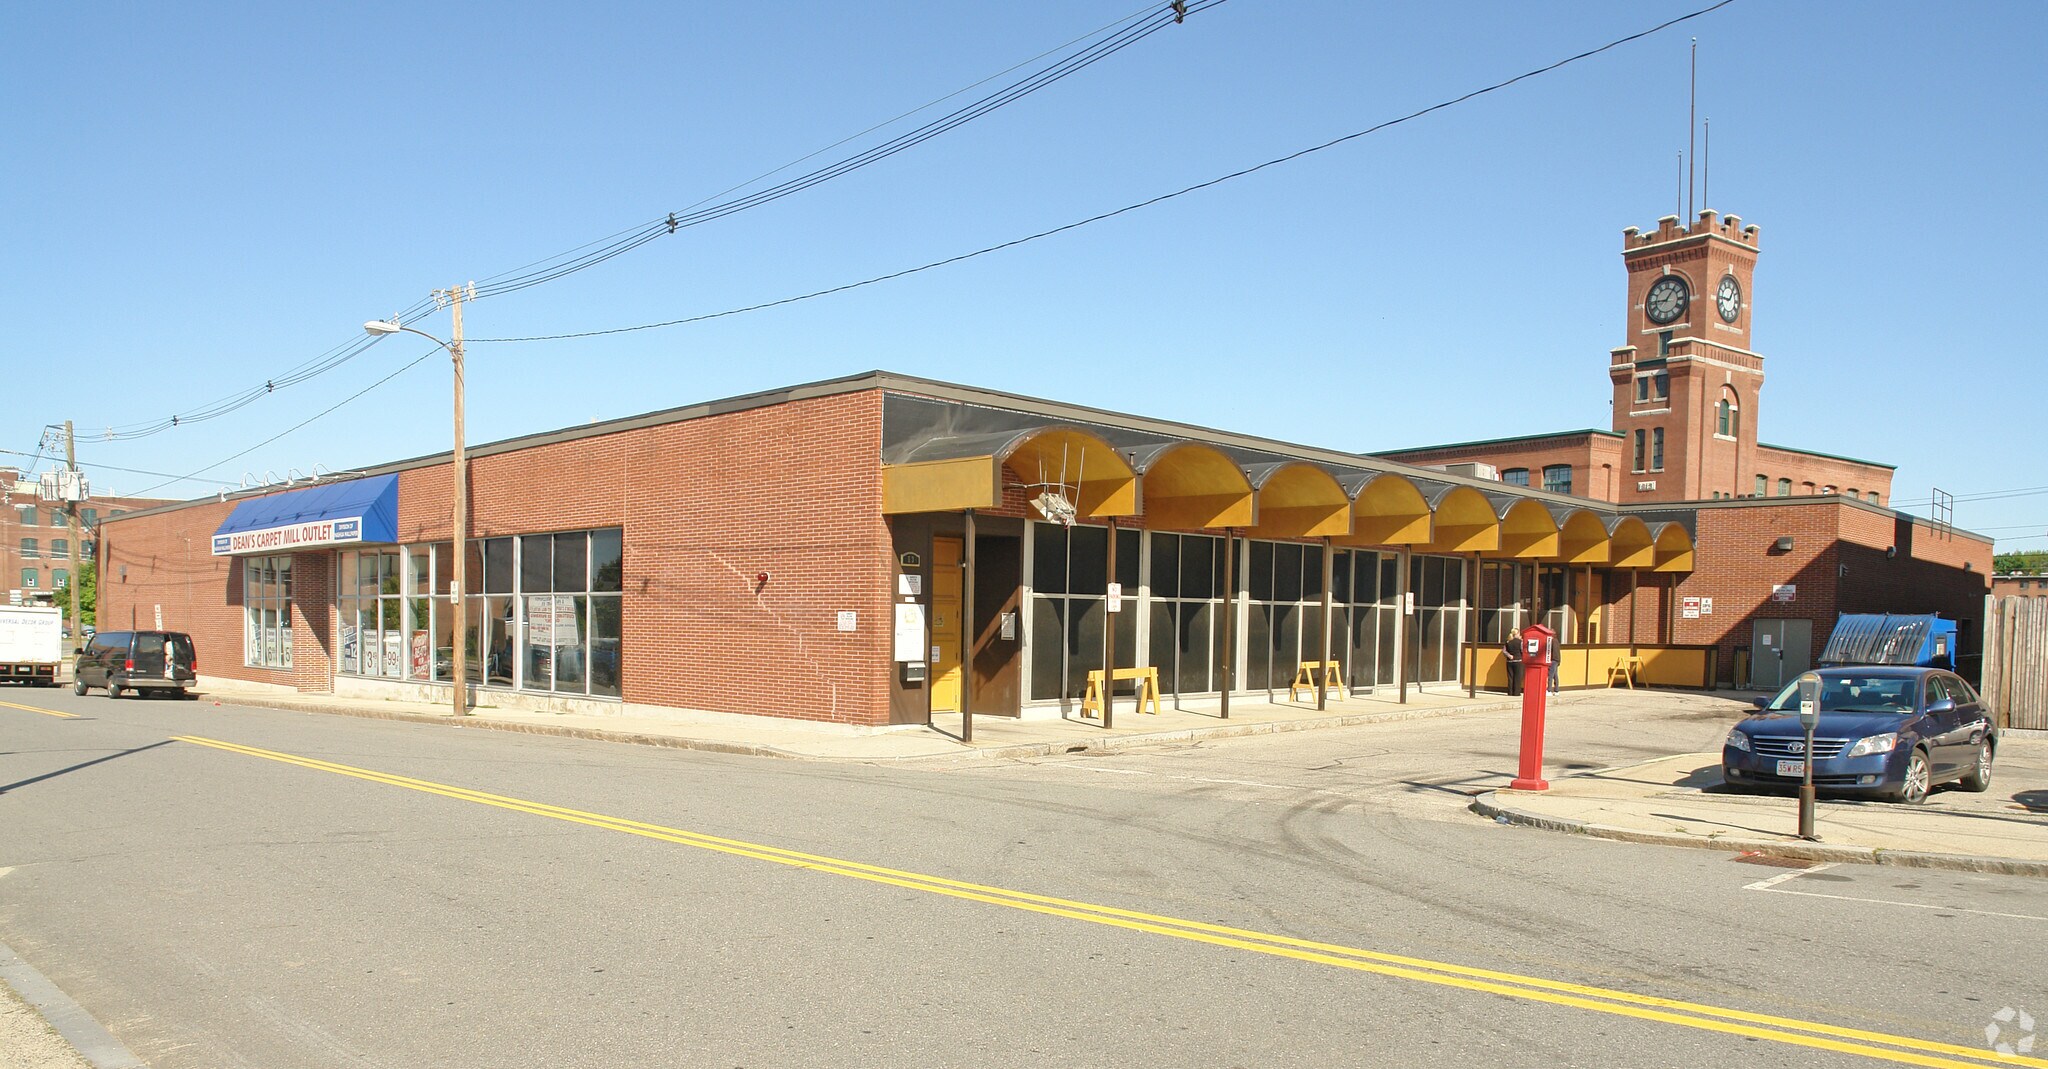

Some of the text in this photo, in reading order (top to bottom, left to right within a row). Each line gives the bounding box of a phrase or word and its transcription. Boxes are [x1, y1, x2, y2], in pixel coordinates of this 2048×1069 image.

[232, 524, 332, 550] DEAN'S CARPET MILL OUTLET
